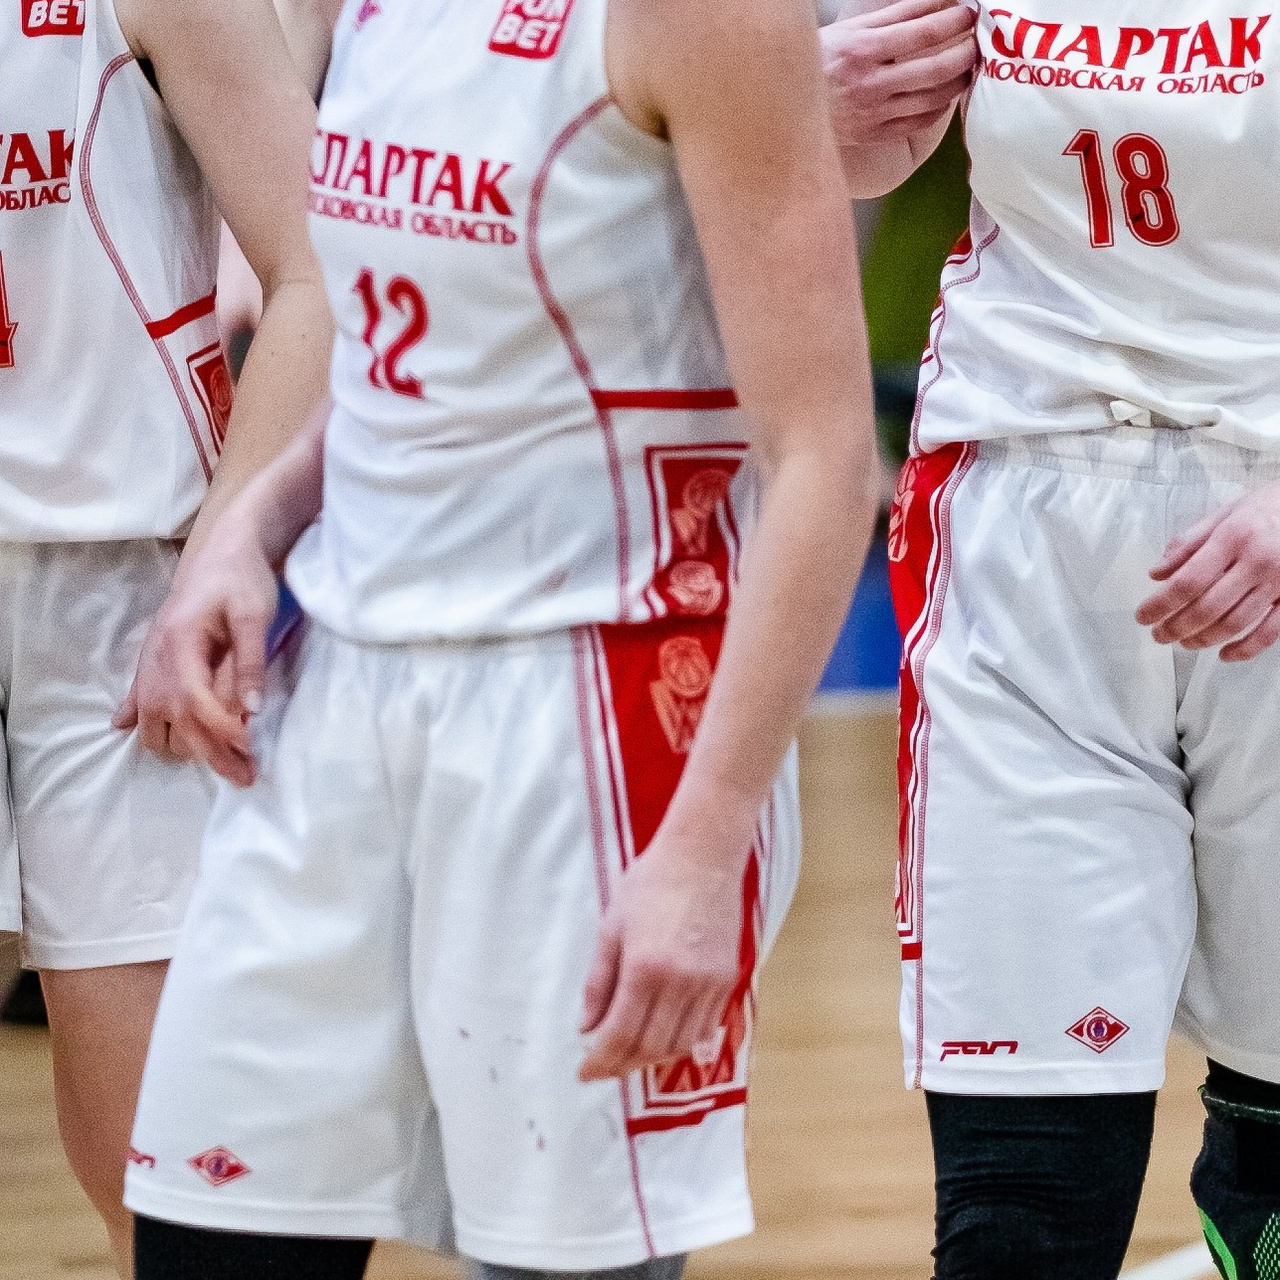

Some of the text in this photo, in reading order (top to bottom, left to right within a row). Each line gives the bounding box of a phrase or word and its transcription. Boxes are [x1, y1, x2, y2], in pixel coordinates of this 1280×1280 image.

[494, 12, 561, 52] BET
[988, 8, 1272, 73] СПАРТАК
[1062, 128, 1181, 249] 18
[351, 266, 430, 401] 12
